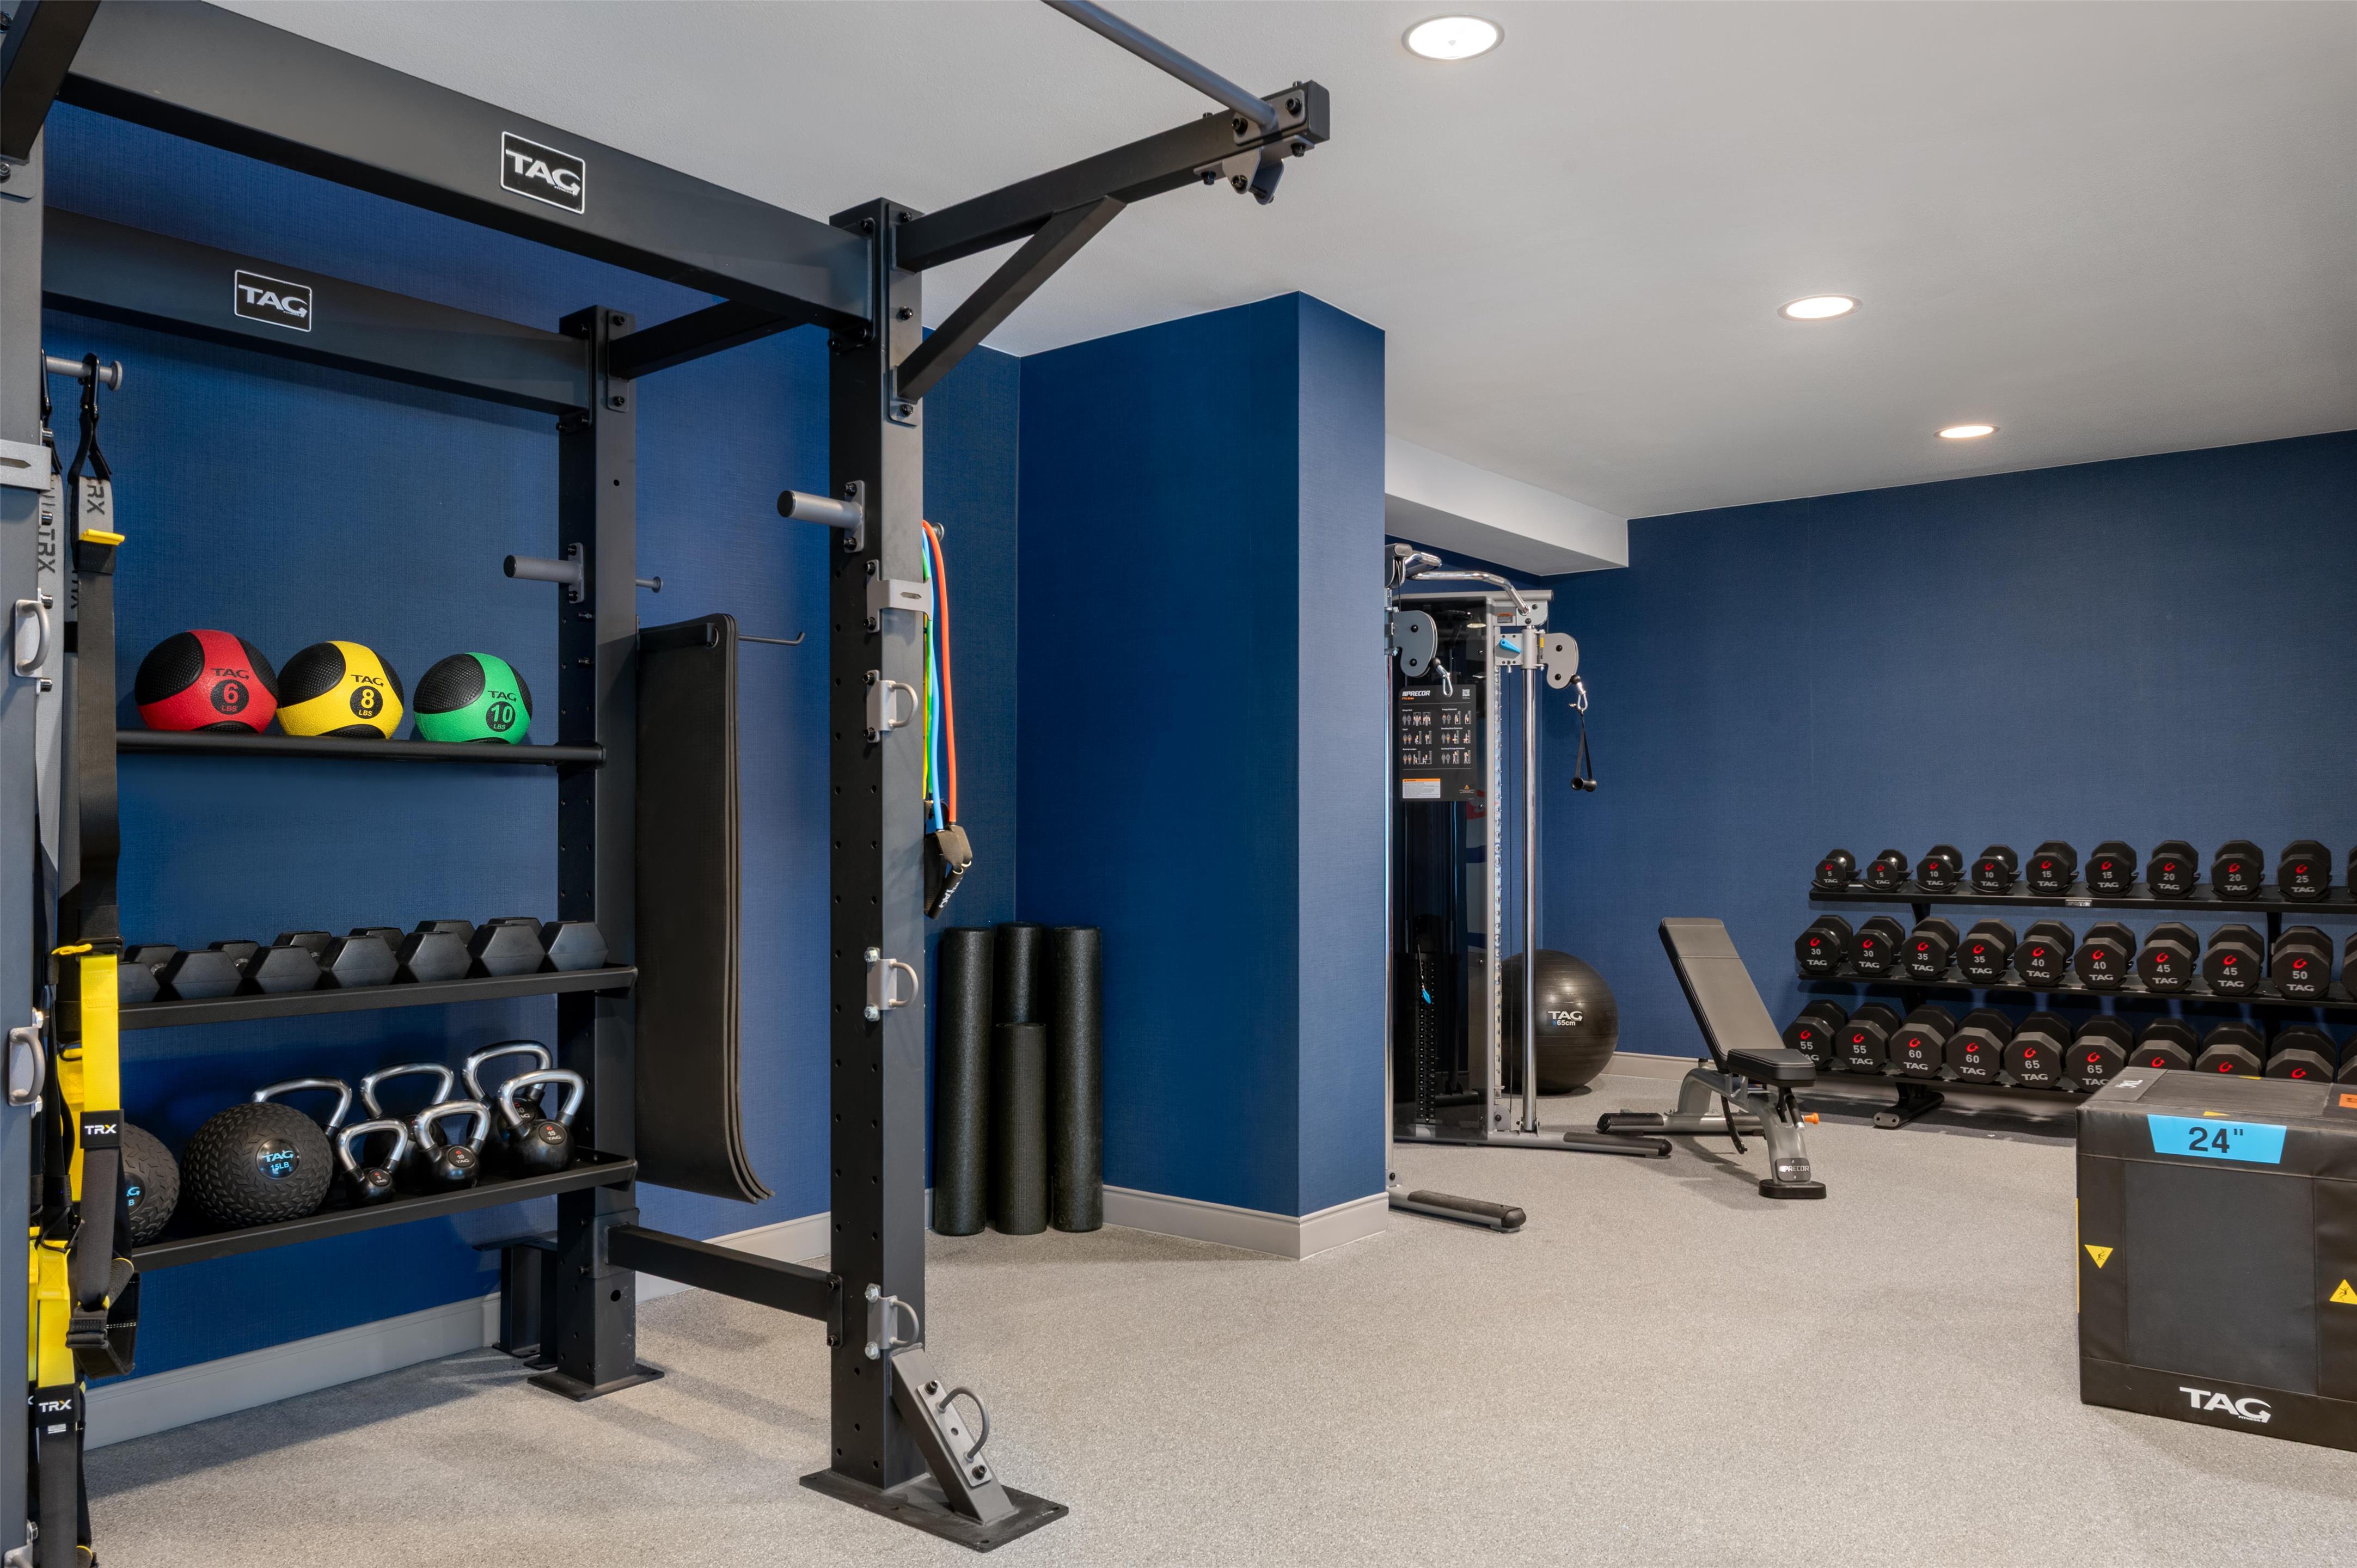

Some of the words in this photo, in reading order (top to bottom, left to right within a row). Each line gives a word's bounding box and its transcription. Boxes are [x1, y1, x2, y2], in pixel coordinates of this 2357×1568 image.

[505, 149, 581, 197] TAG
[238, 284, 308, 318] TAG
[87, 484, 105, 514] RX
[38, 529, 56, 573] TRX
[210, 667, 249, 679] TAG
[351, 674, 384, 687] TAG
[224, 683, 238, 703] 6
[361, 689, 374, 708] 8
[487, 690, 517, 702] TAG
[491, 705, 513, 723] 10
[2032, 959, 2044, 967] 40
[2093, 961, 2106, 970] 40
[2027, 970, 2049, 978] TAG
[2157, 965, 2170, 973] 45
[2223, 967, 2237, 976] 45
[2293, 971, 2307, 979] 50
[1548, 1010, 1583, 1021] TAG
[1801, 1042, 1813, 1050] 55
[1853, 1045, 1866, 1054] 55
[1909, 1050, 1921, 1059] 60
[1966, 1055, 1979, 1063] 60
[1903, 1062, 1928, 1071] TAG
[2025, 1061, 2040, 1069] 65
[2087, 1065, 2102, 1074] 65
[1960, 1067, 1986, 1076] TAG
[84, 1124, 117, 1135] TRX
[2188, 1126, 2244, 1153] 24"
[262, 1150, 294, 1162] TAG
[270, 1161, 290, 1171] 15LB
[38, 1399, 72, 1413] TRX
[2180, 1387, 2272, 1423] TAG
